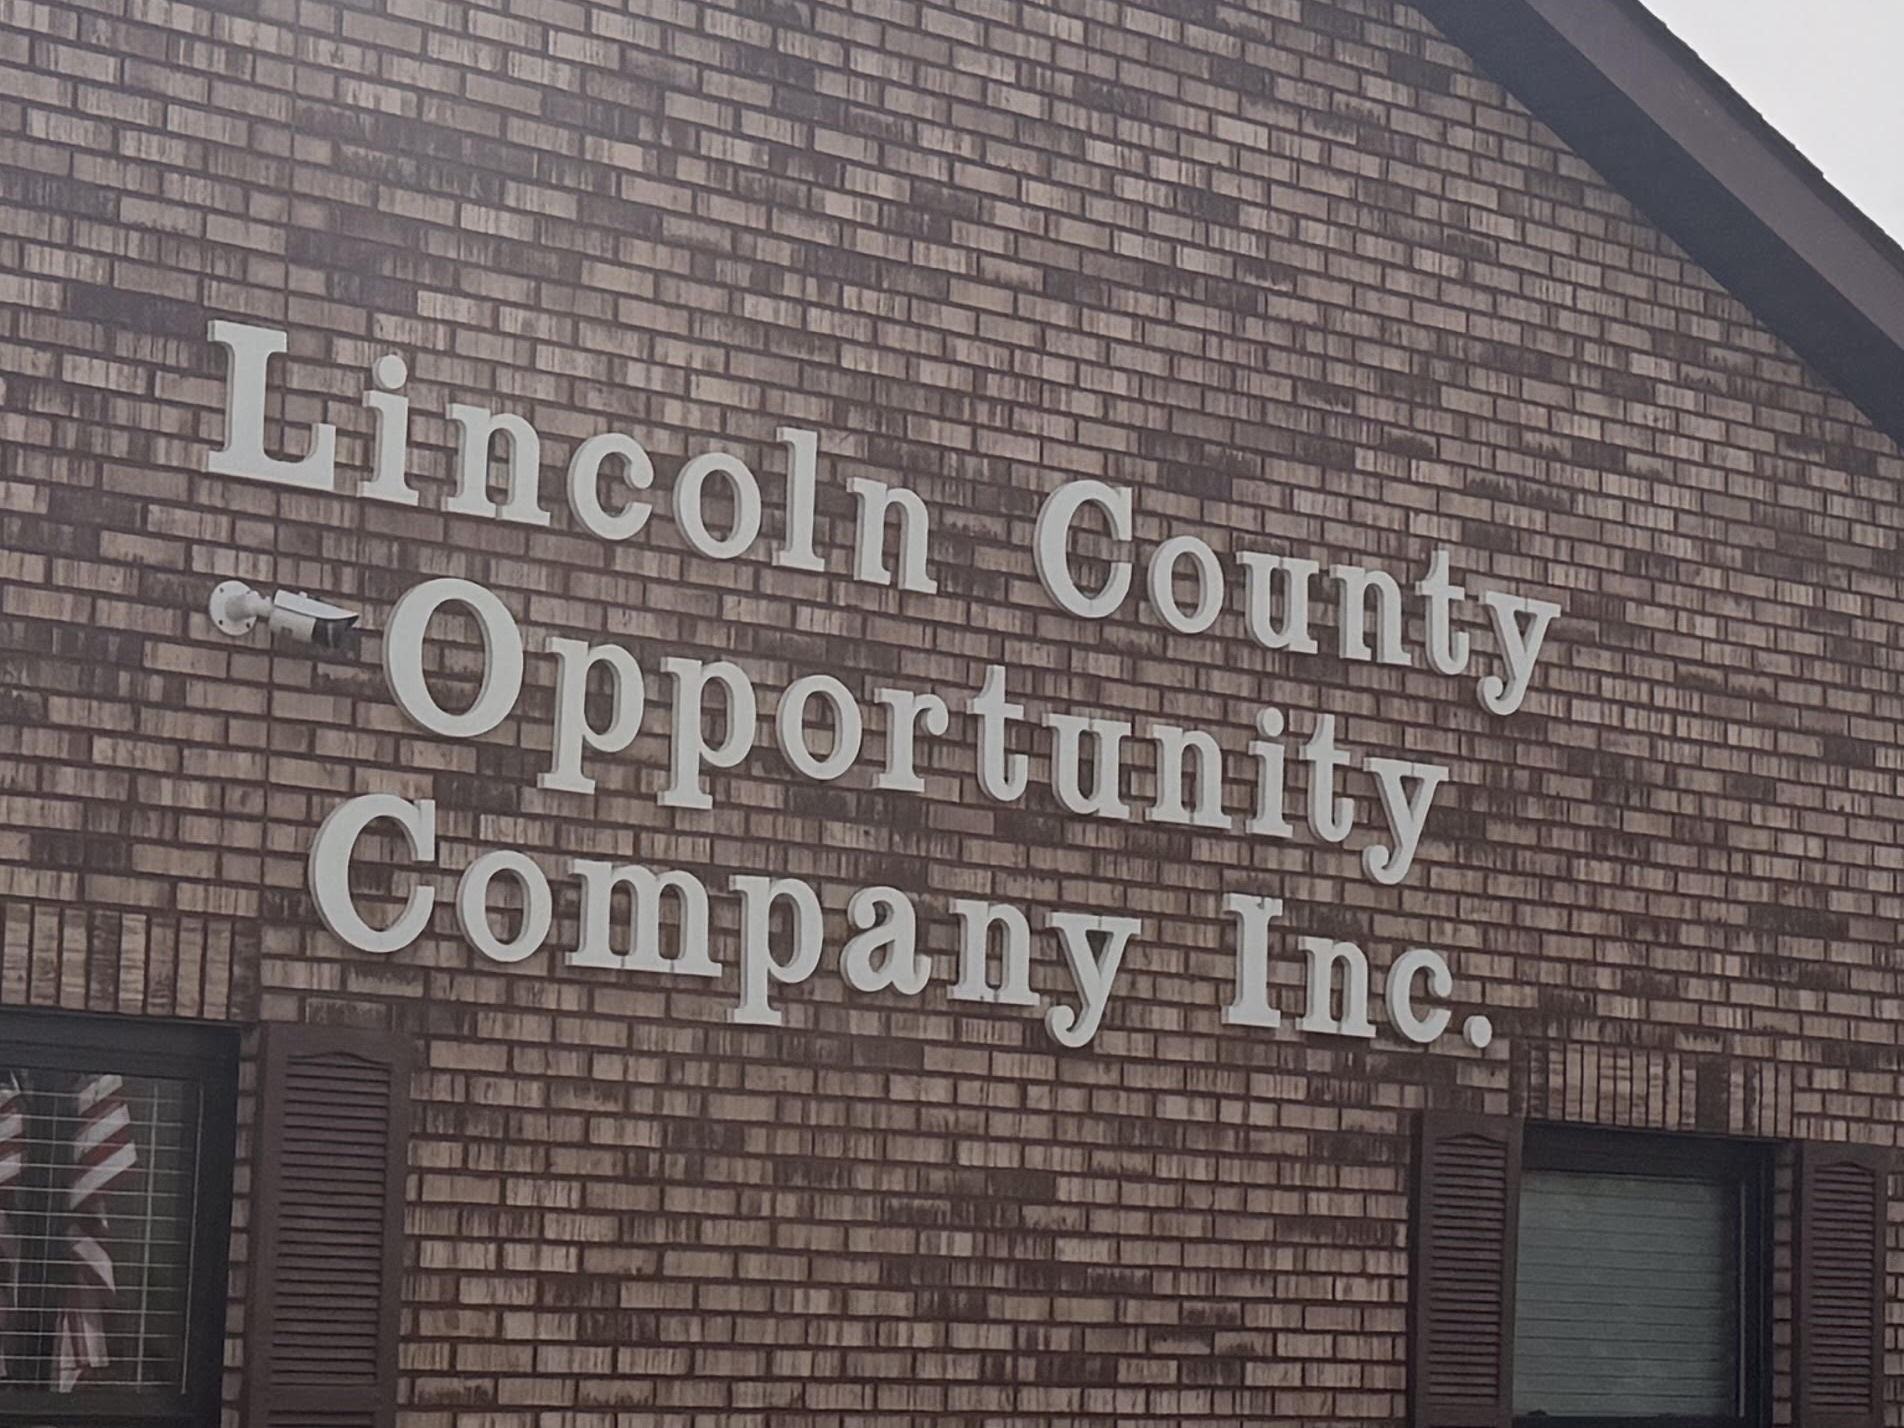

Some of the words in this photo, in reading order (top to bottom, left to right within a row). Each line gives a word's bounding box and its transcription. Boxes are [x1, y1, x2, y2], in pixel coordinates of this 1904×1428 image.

[207, 320, 938, 594] Lincoln
[1033, 479, 1562, 716] County
[383, 578, 1449, 885] Opportunity
[308, 793, 1142, 1048] Company
[1222, 893, 1494, 1049] Inc.
